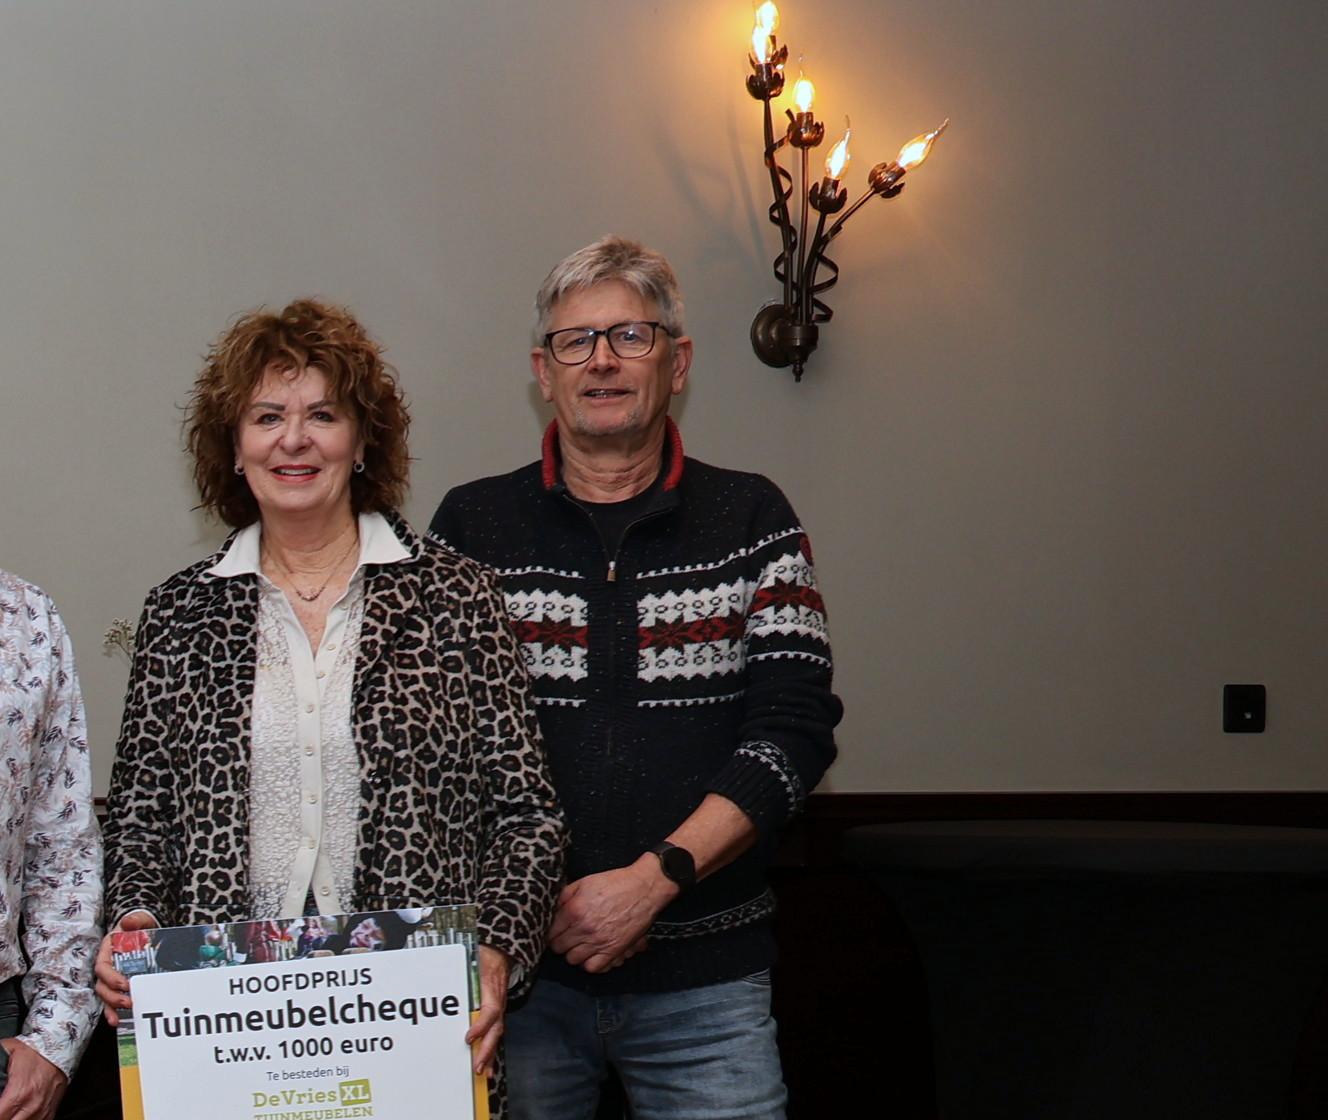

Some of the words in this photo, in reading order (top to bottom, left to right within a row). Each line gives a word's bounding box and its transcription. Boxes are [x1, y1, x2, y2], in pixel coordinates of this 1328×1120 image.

[229, 967, 372, 995] HOOFDPRIJS
[142, 993, 460, 1039] Tuinmeubelcheque
[213, 1045, 271, 1064] t.w.v.
[278, 1036, 334, 1059] 1000
[340, 1035, 394, 1055] euro
[266, 1071, 280, 1081] Te
[282, 1067, 334, 1080] besteden
[336, 1065, 350, 1078] bij
[341, 1084, 370, 1102] XL
